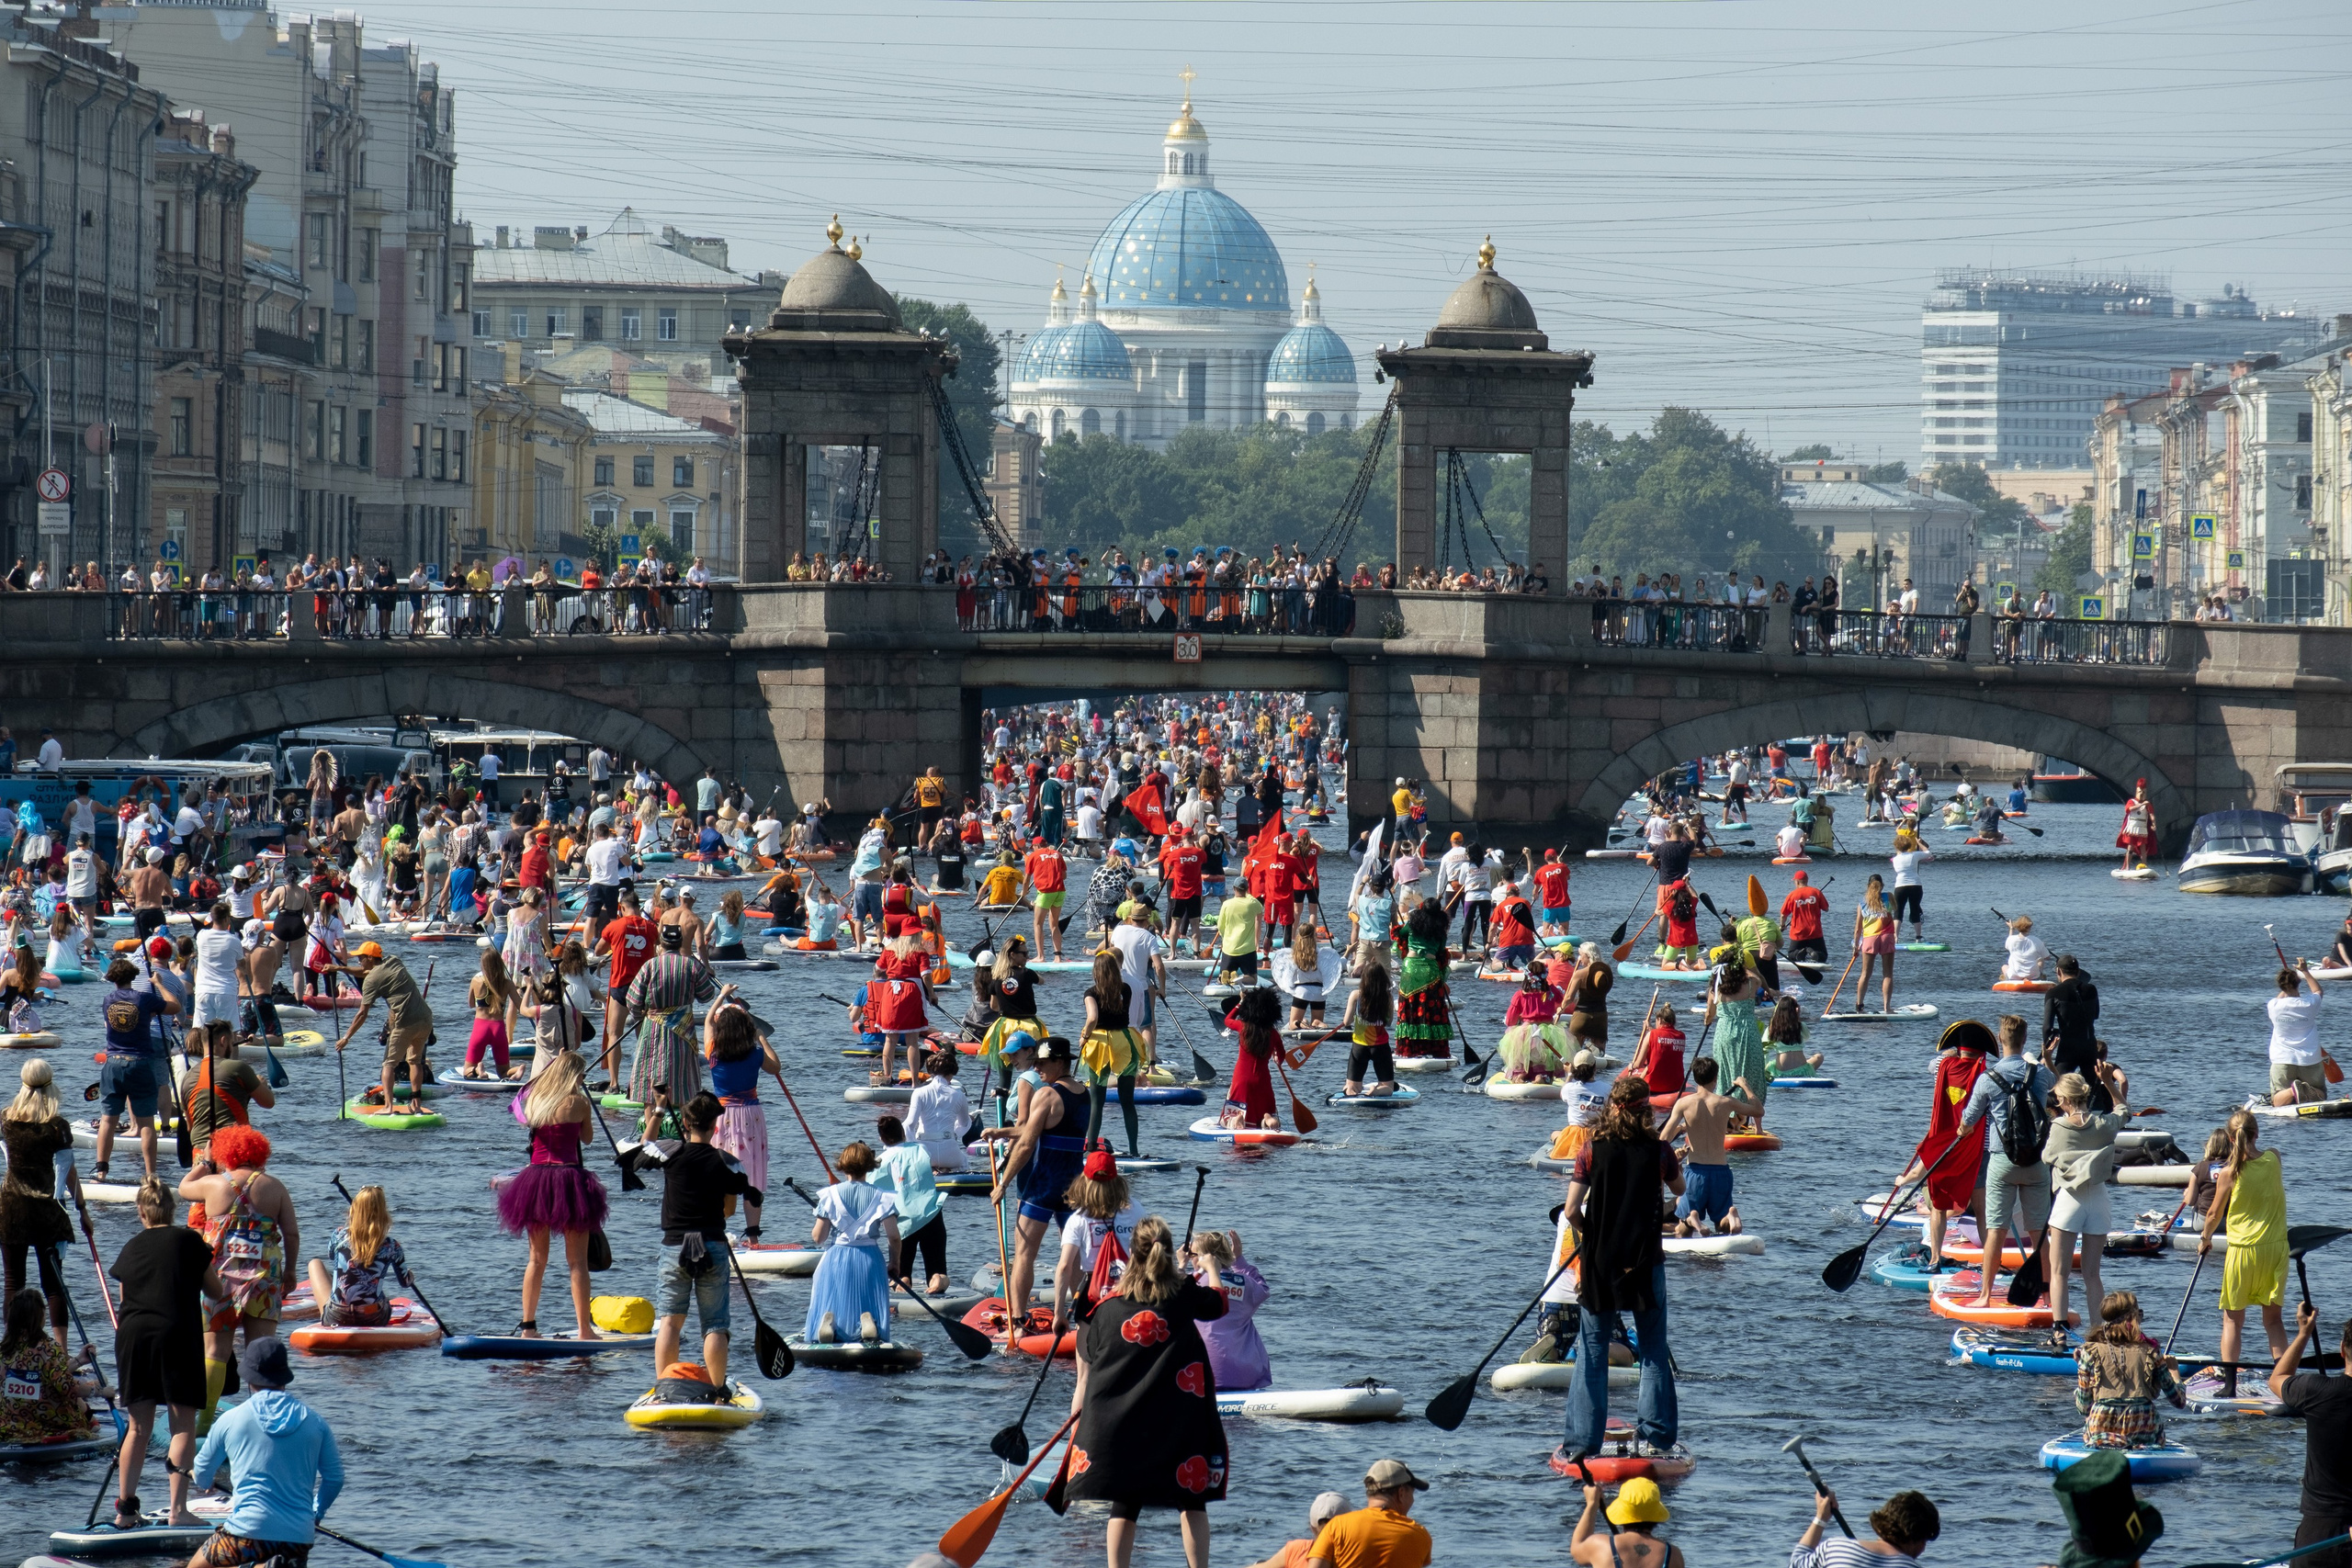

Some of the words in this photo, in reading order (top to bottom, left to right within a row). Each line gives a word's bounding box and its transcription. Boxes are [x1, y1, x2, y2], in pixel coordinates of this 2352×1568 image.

[924, 787, 936, 797] 55
[626, 934, 646, 950] 70
[1657, 1037, 1685, 1045] ОСТОРОЖН
[228, 1242, 260, 1256] 5224
[1996, 1357, 2023, 1368] Feath-R-Lite
[8, 1383, 35, 1395] 5210
